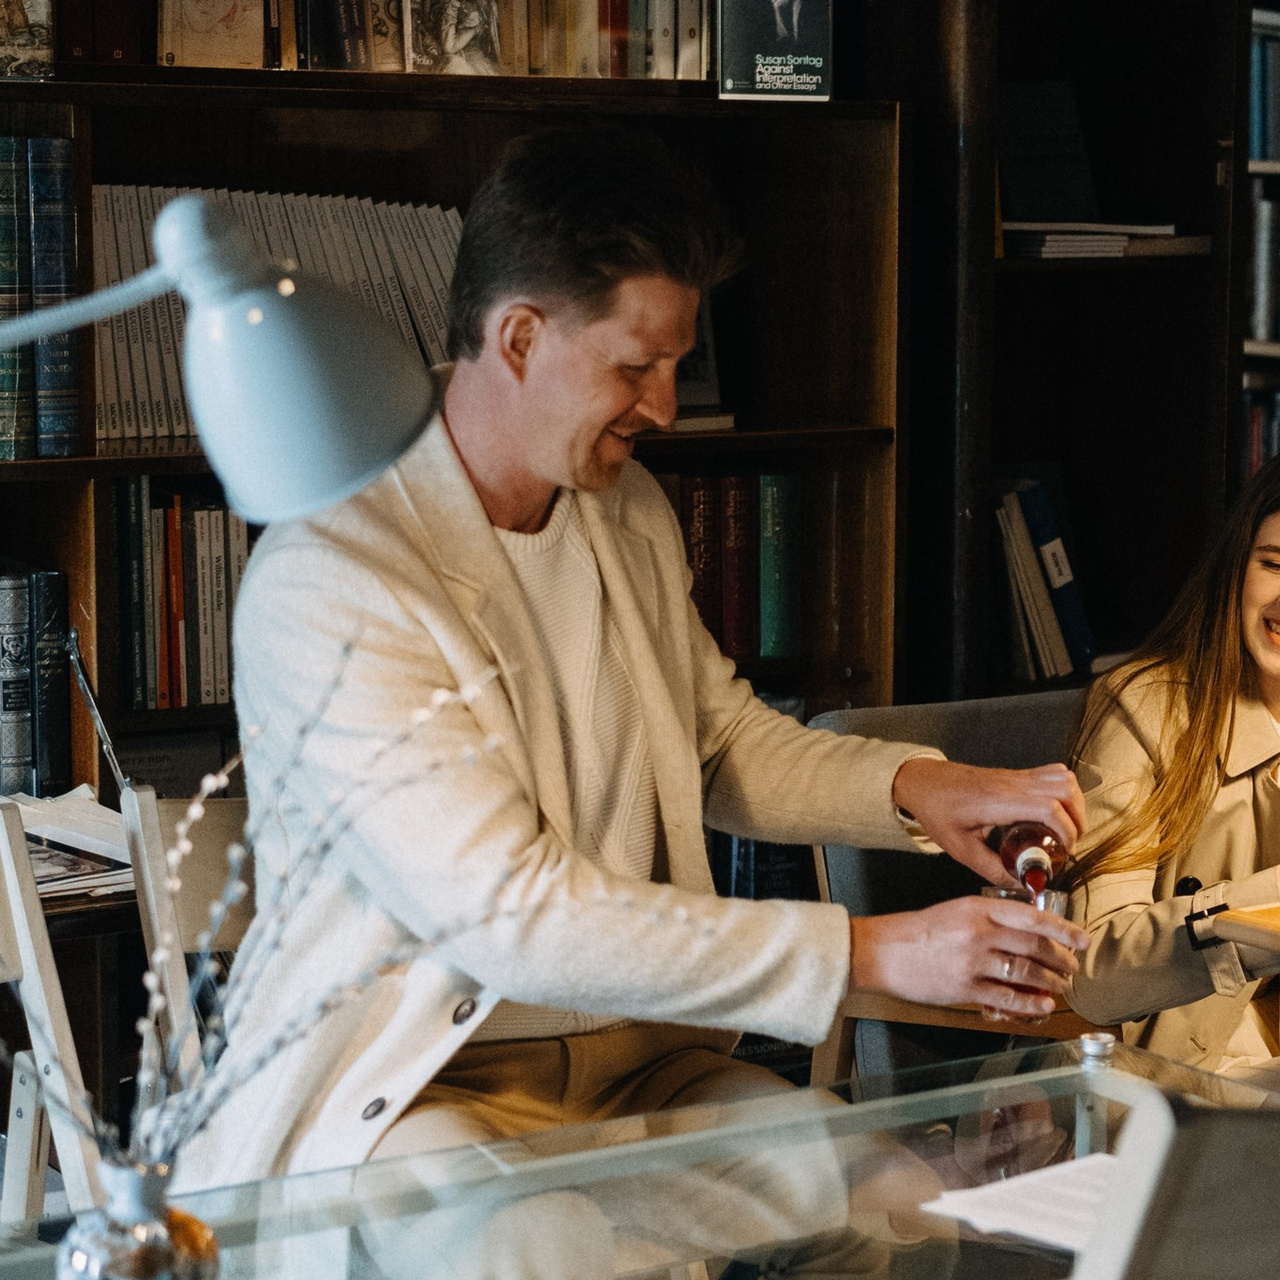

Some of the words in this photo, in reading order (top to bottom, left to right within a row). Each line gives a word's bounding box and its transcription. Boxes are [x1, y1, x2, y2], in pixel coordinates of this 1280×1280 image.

[756, 53, 786, 65] Susan
[787, 54, 822, 68] Sontag
[756, 64, 794, 74] Against
[756, 73, 821, 84] Interpretation
[772, 82, 792, 90] Other
[793, 82, 817, 91] Essays
[388, 275, 398, 292] ROY
[394, 292, 418, 351] LICHTENSTEIN
[410, 286, 422, 311] HENRI
[420, 312, 435, 344] MATISSE
[429, 301, 444, 330] CUBISM
[160, 326, 171, 355] BOSCH
